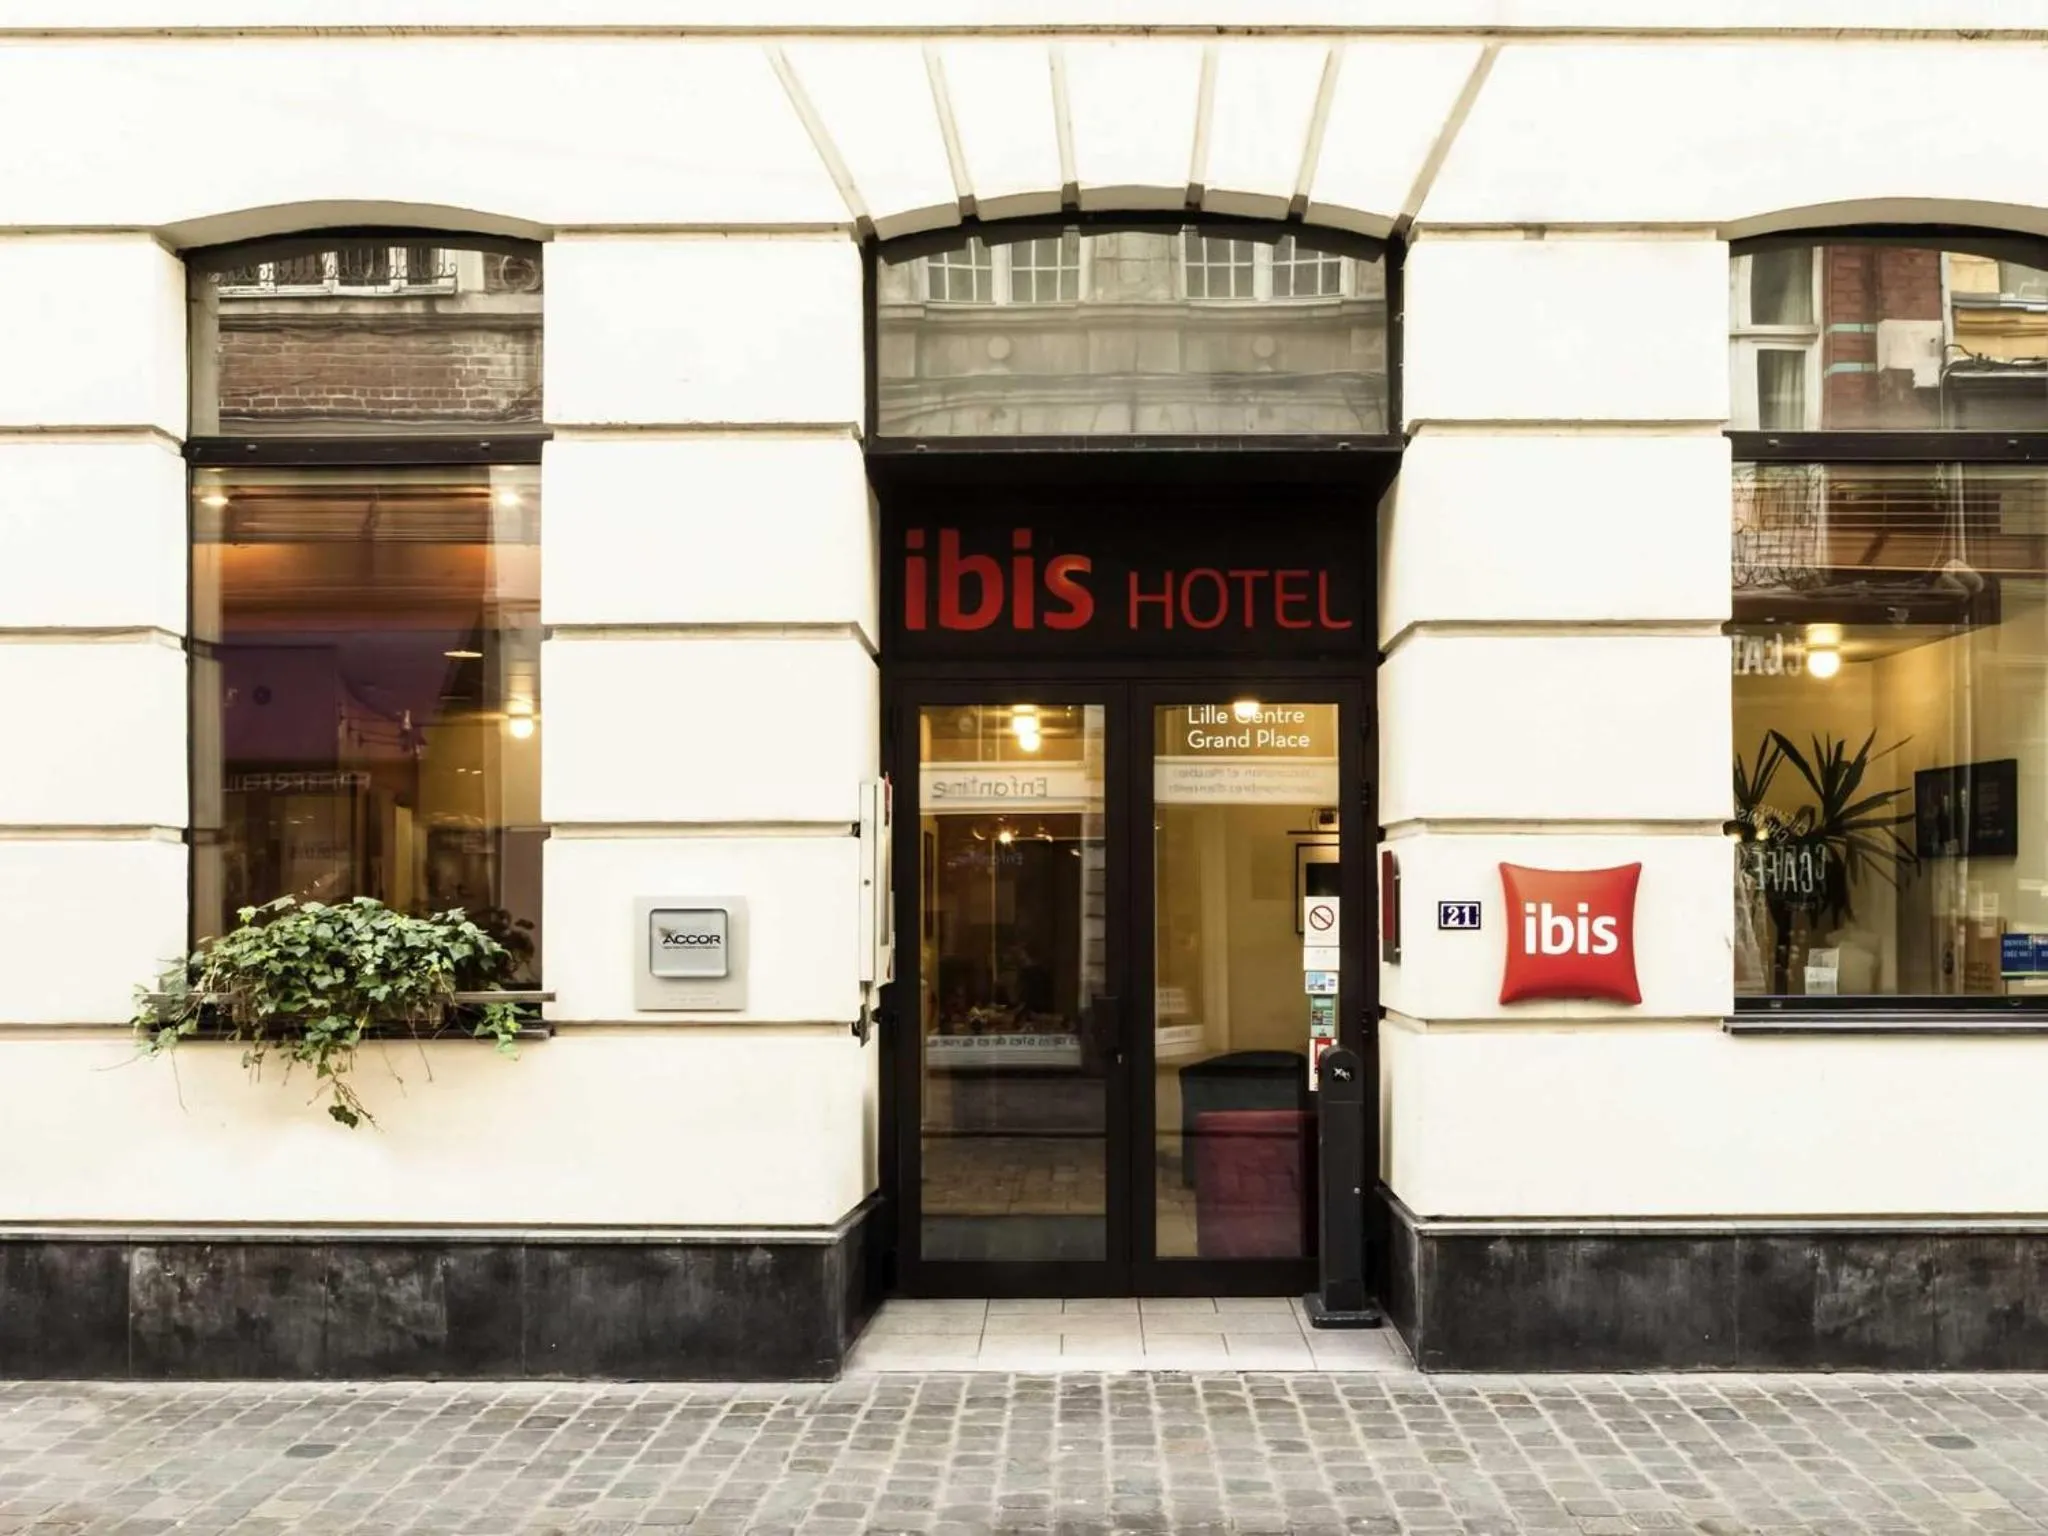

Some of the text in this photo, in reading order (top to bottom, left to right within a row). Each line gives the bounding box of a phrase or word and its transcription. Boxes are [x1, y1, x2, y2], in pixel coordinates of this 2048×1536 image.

[905, 528, 1353, 631] ibis HOTEL
[1188, 704, 1305, 725] Lille Centre
[1187, 729, 1311, 749] Grand Place
[1447, 906, 1472, 926] 21
[1523, 902, 1619, 955] ibis
[664, 934, 721, 945] ACCOR
